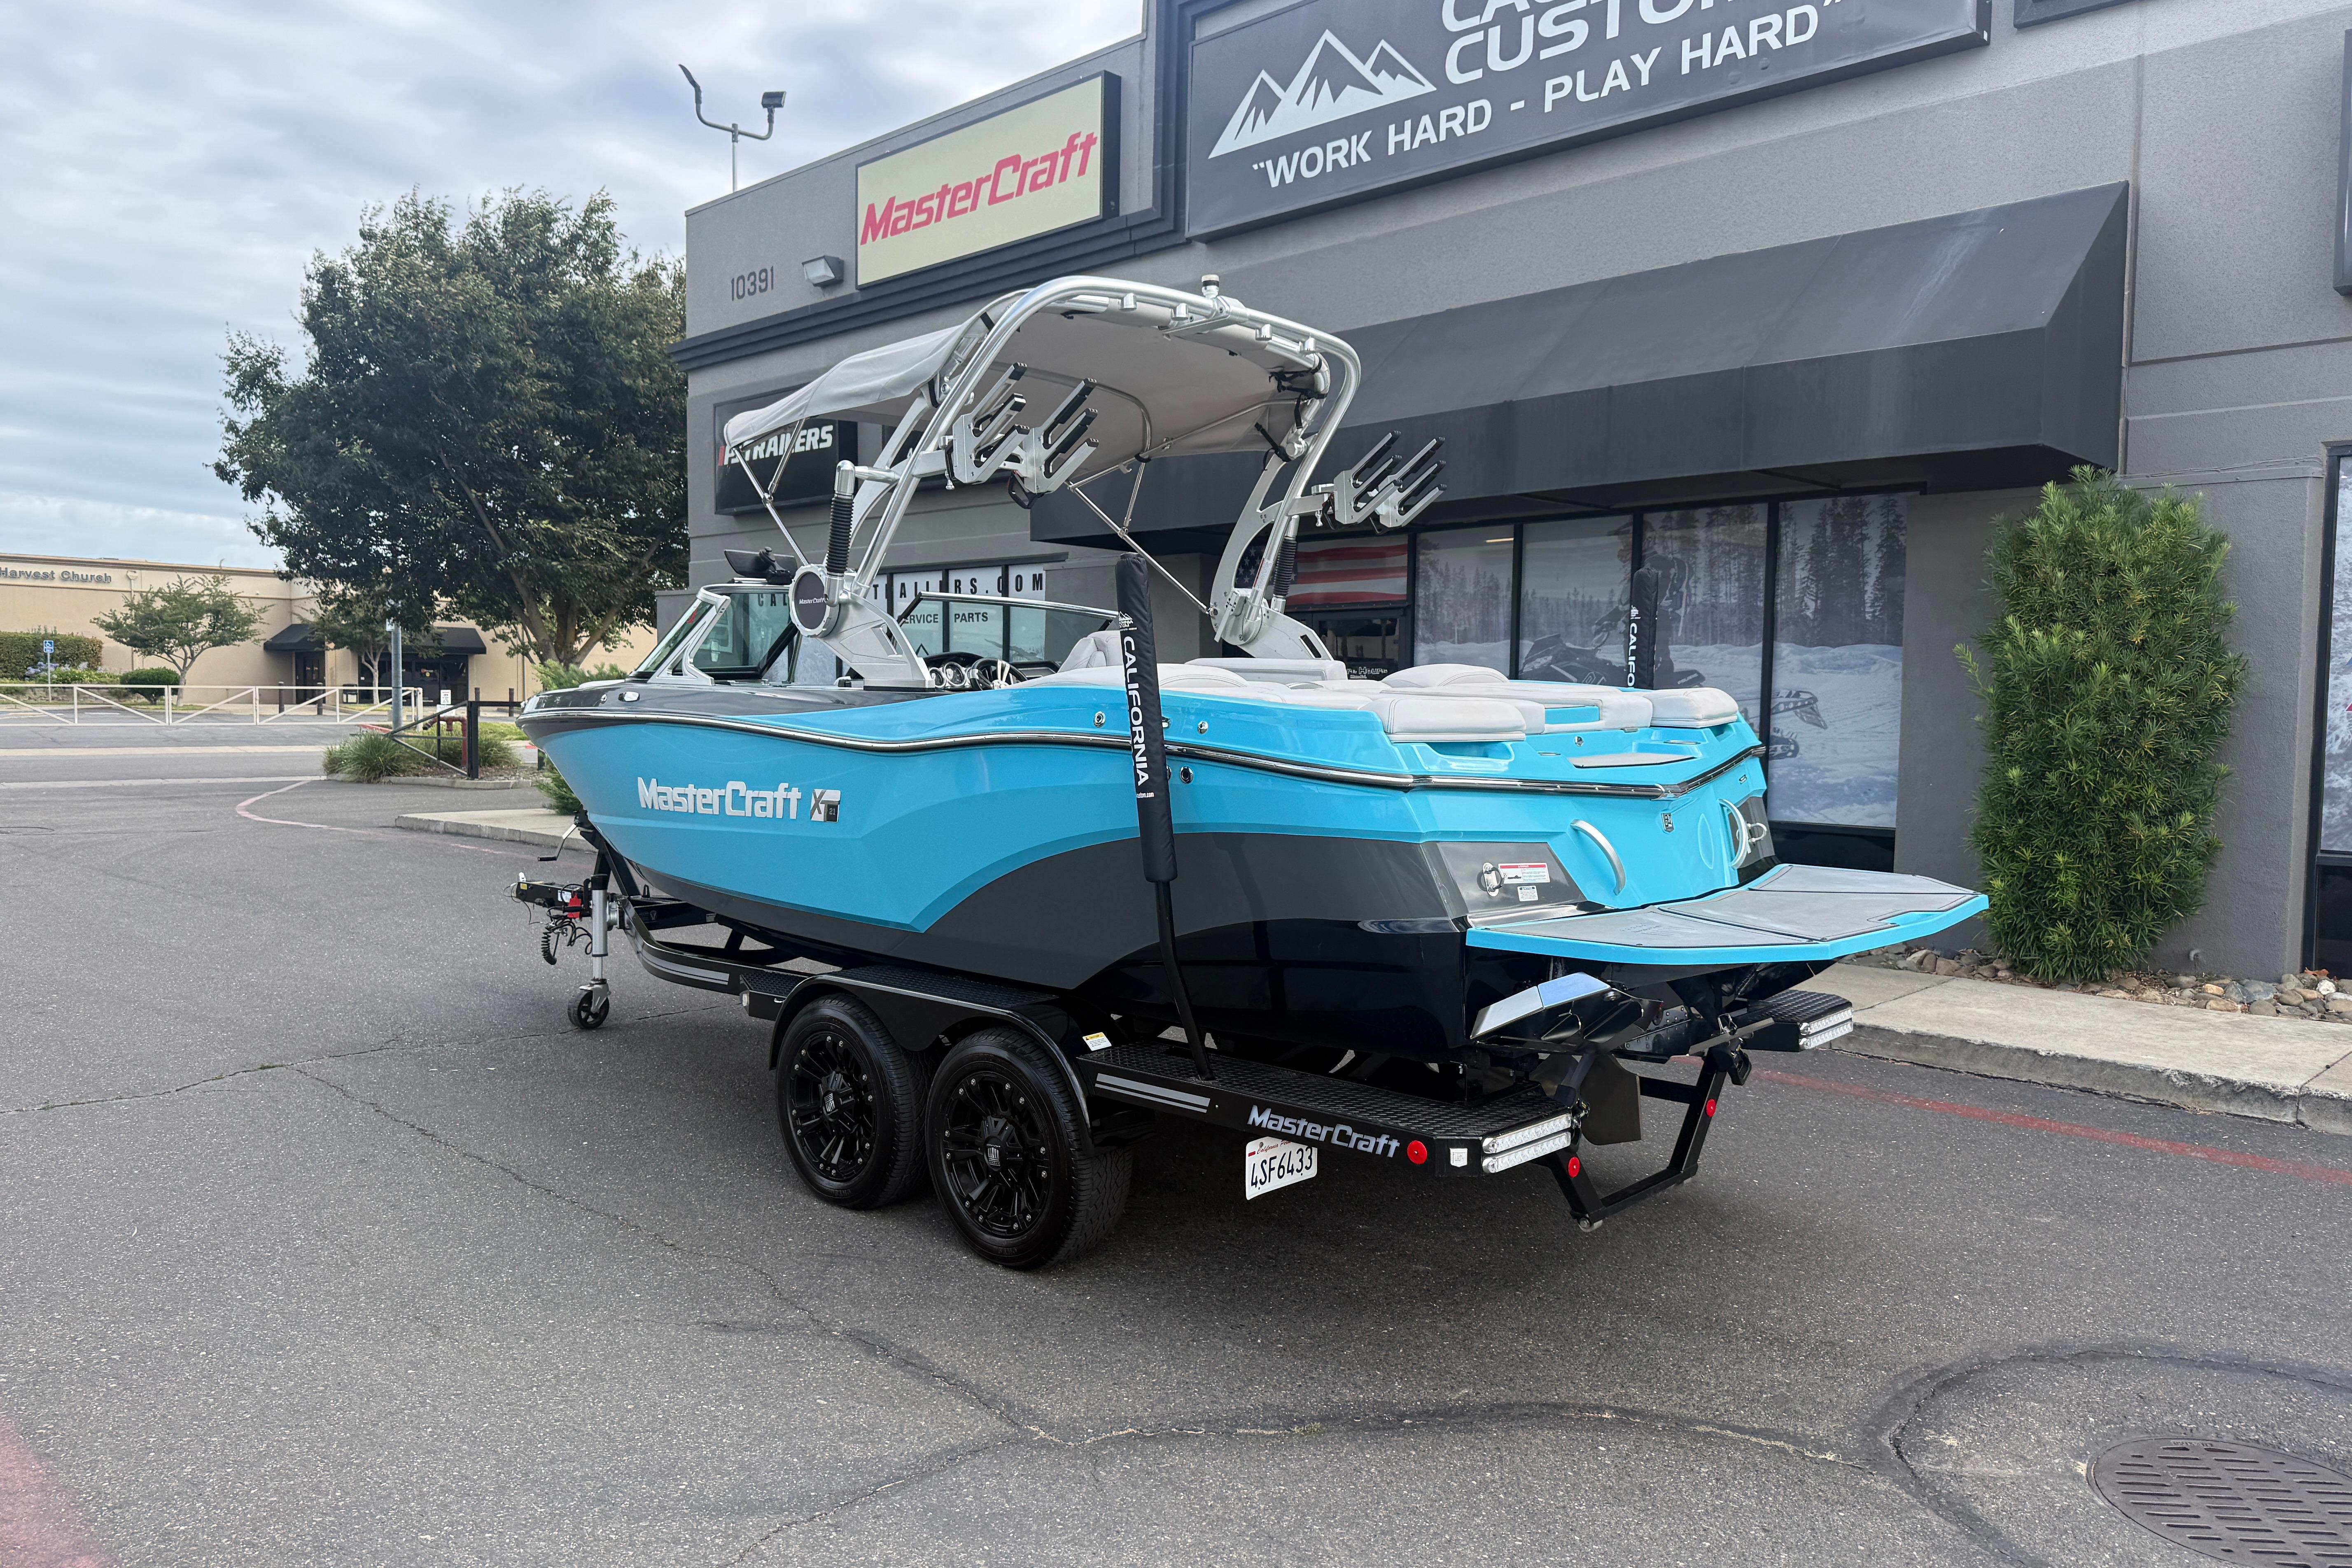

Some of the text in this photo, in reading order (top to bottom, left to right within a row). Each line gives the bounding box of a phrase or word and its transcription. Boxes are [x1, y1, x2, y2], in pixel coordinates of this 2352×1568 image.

[1445, 0, 1734, 84] CUSTO
[1388, 99, 1492, 155] HARD
[1545, 47, 1662, 113] PLAY
[860, 131, 1098, 246] MasterCraft
[731, 266, 774, 301] 10391
[0, 567, 112, 583] Harvest Church
[902, 611, 989, 624] ERVICE PARTS
[1627, 623, 1637, 688] CALIFO
[1123, 636, 1150, 786] CALIFORNIA
[637, 777, 802, 820] MasterCraft
[1247, 1104, 1400, 1158] MasterCraft
[1251, 1146, 1313, 1188] 4SF6433
